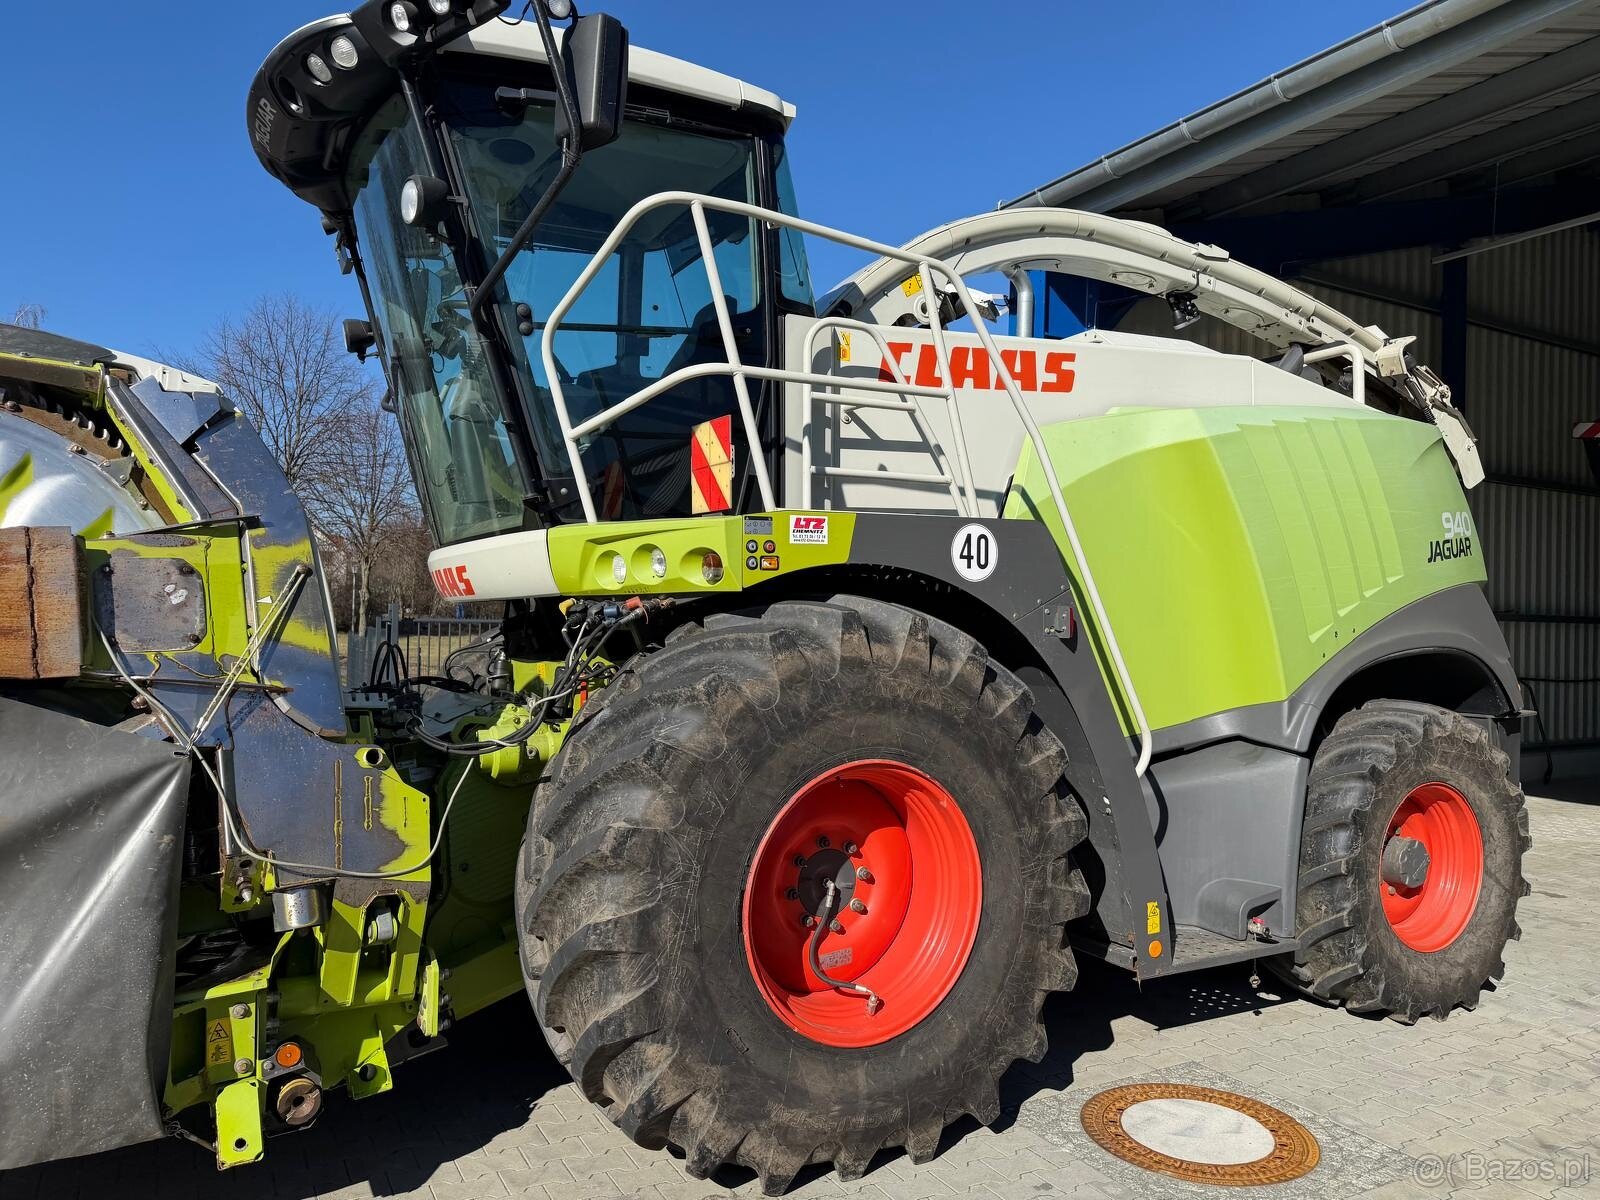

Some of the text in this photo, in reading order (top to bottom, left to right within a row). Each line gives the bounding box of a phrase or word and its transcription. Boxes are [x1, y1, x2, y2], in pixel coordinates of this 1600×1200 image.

[255, 97, 277, 153] JAGUAR
[878, 341, 1077, 393] CLAAS
[794, 517, 826, 529] LTZ
[1441, 511, 1472, 539] 940
[959, 533, 989, 570] 40
[1427, 537, 1473, 564] JAGUAR
